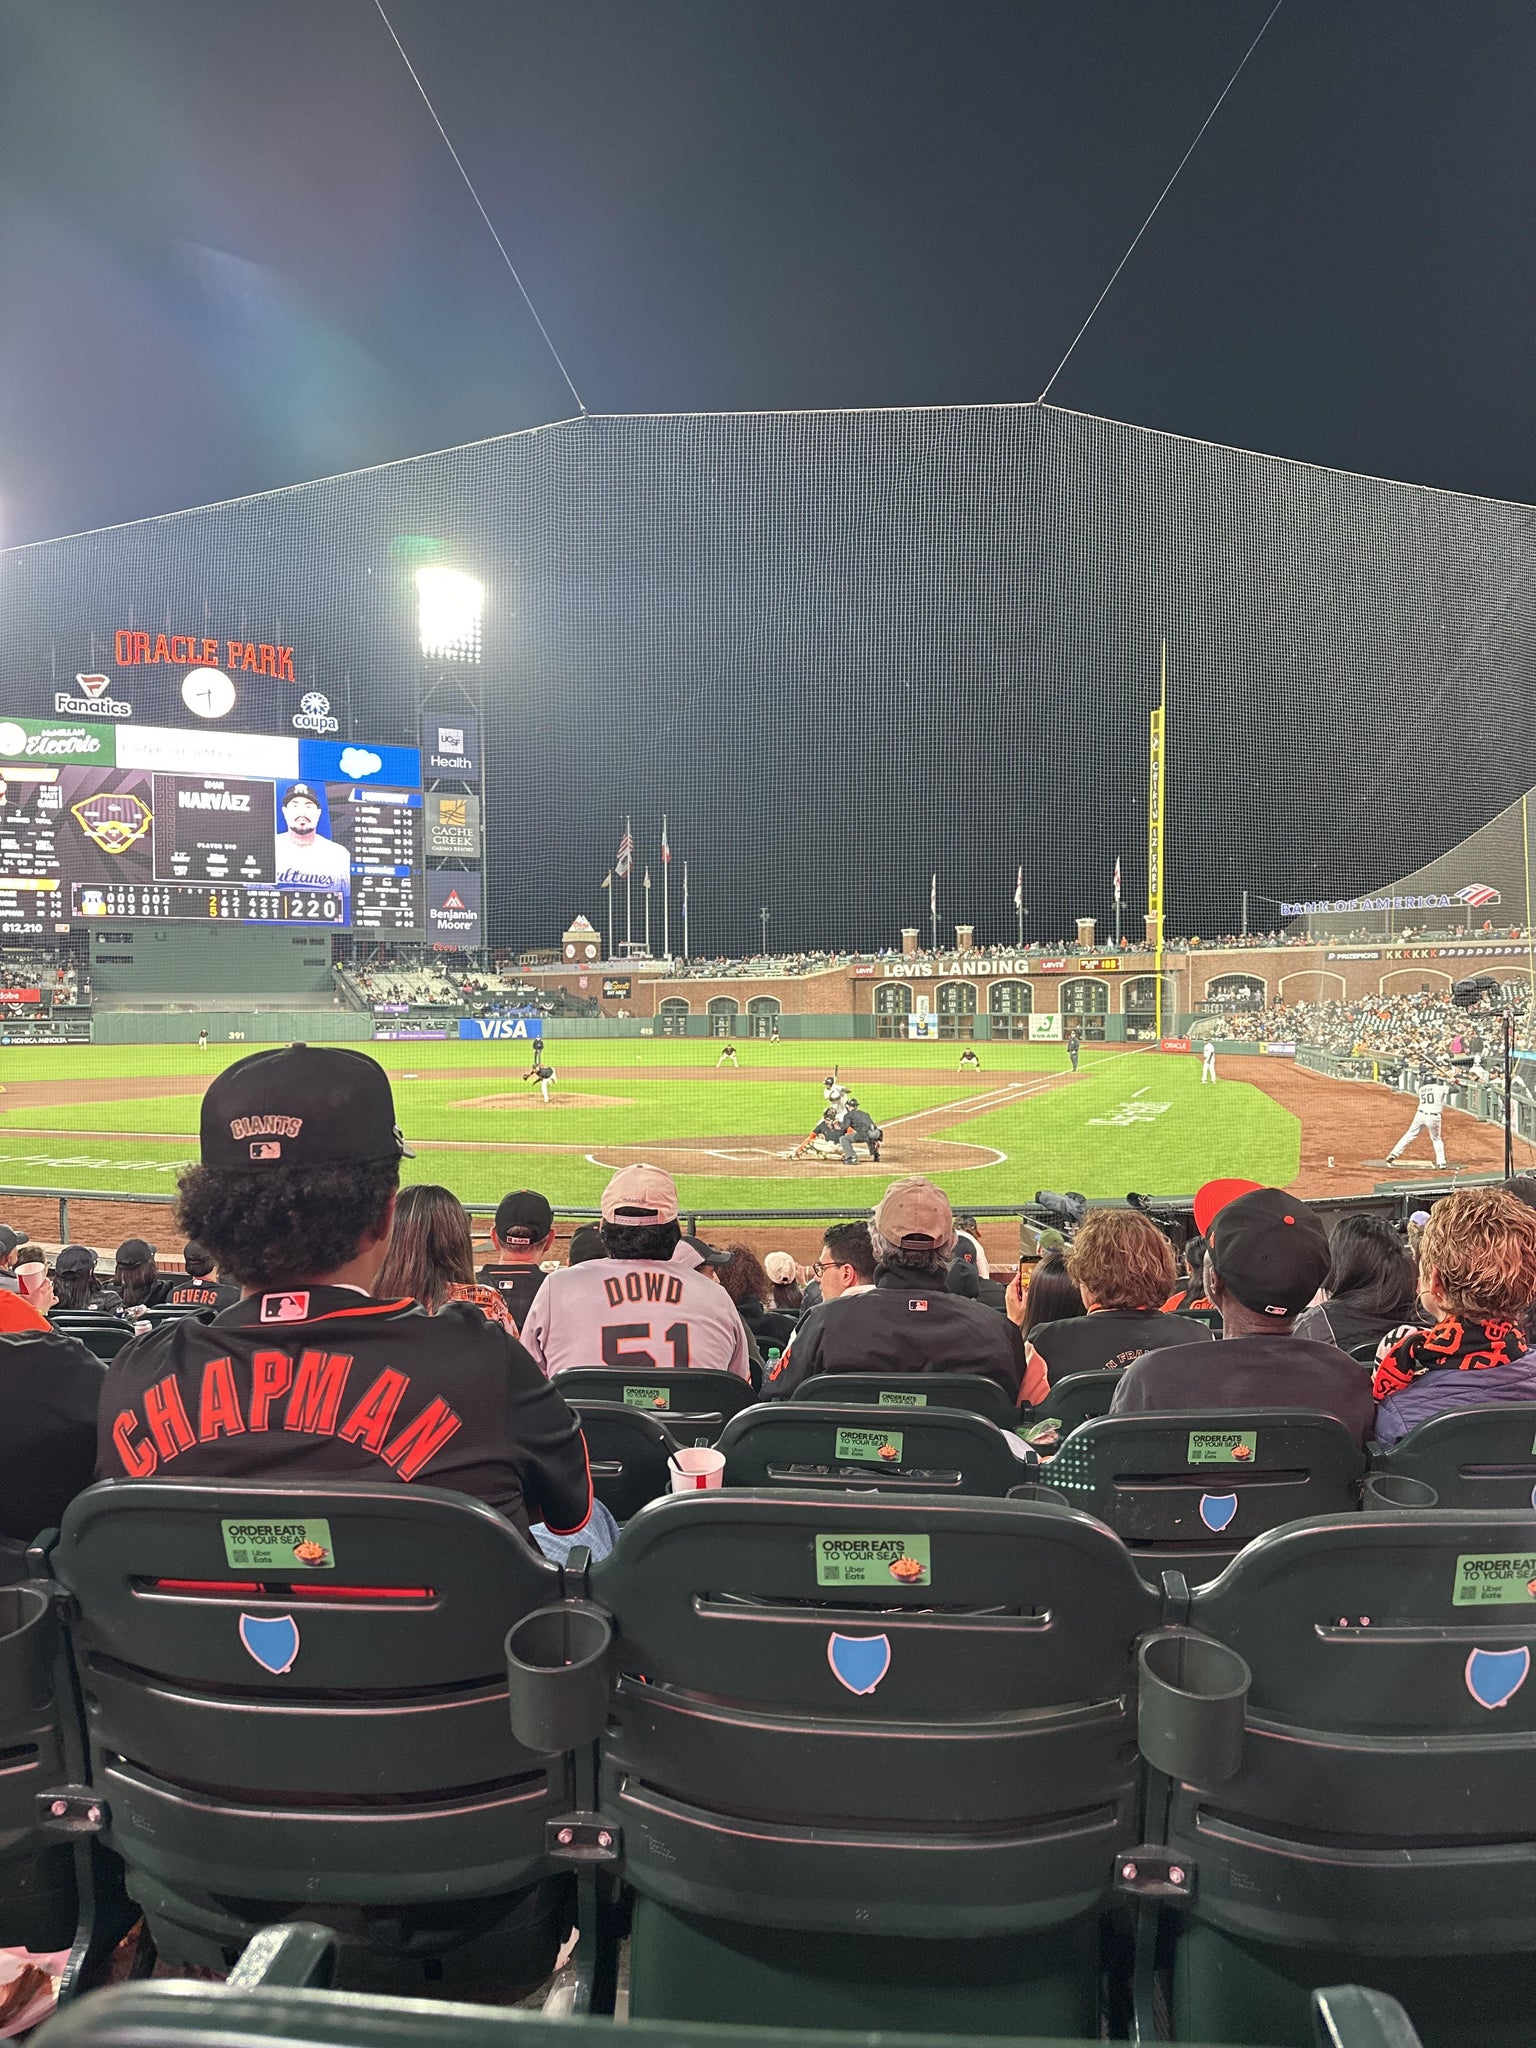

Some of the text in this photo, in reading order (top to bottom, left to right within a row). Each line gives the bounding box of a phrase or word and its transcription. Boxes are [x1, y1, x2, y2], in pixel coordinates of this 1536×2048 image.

[115, 630, 295, 682] ORACLE PARK
[57, 694, 130, 715] Fanatics
[294, 714, 336, 731] coupa
[25, 735, 100, 755] Electric
[431, 755, 472, 769] Health
[178, 791, 250, 812] NARVÁEZ
[432, 826, 474, 837] CACHE
[433, 836, 472, 846] CREEK
[277, 869, 333, 885] ultanes
[1281, 894, 1451, 916] BANK OF AMERICA
[430, 909, 478, 921] Benjamin
[2, 922, 43, 933] $12,210
[437, 919, 470, 930] Moore
[938, 960, 1029, 976] LANDING
[0, 992, 19, 1000] dobe
[475, 1020, 528, 1038] VISA
[228, 1031, 245, 1040] 391
[1138, 1031, 1157, 1040] 309
[1164, 1042, 1187, 1050] ORACLE
[1421, 1092, 1435, 1105] 50
[230, 1114, 303, 1140] GIANTS
[172, 1287, 219, 1305] DEVERS
[603, 1271, 684, 1309] DOWD
[601, 1321, 692, 1368] 51
[112, 1349, 463, 1482] CHAPMAN
[840, 1431, 867, 1440] ORDER
[1193, 1434, 1242, 1442] ORDER EATS
[228, 1525, 306, 1536] ORDER EATS
[231, 1536, 306, 1544] TO YOUR SEAT
[823, 1541, 905, 1551] ORDER EATS
[824, 1552, 904, 1560] TO YOUR SEAT
[1463, 1559, 1536, 1571] ORDER EAT
[1463, 1569, 1536, 1580] TO YOUR SEA
